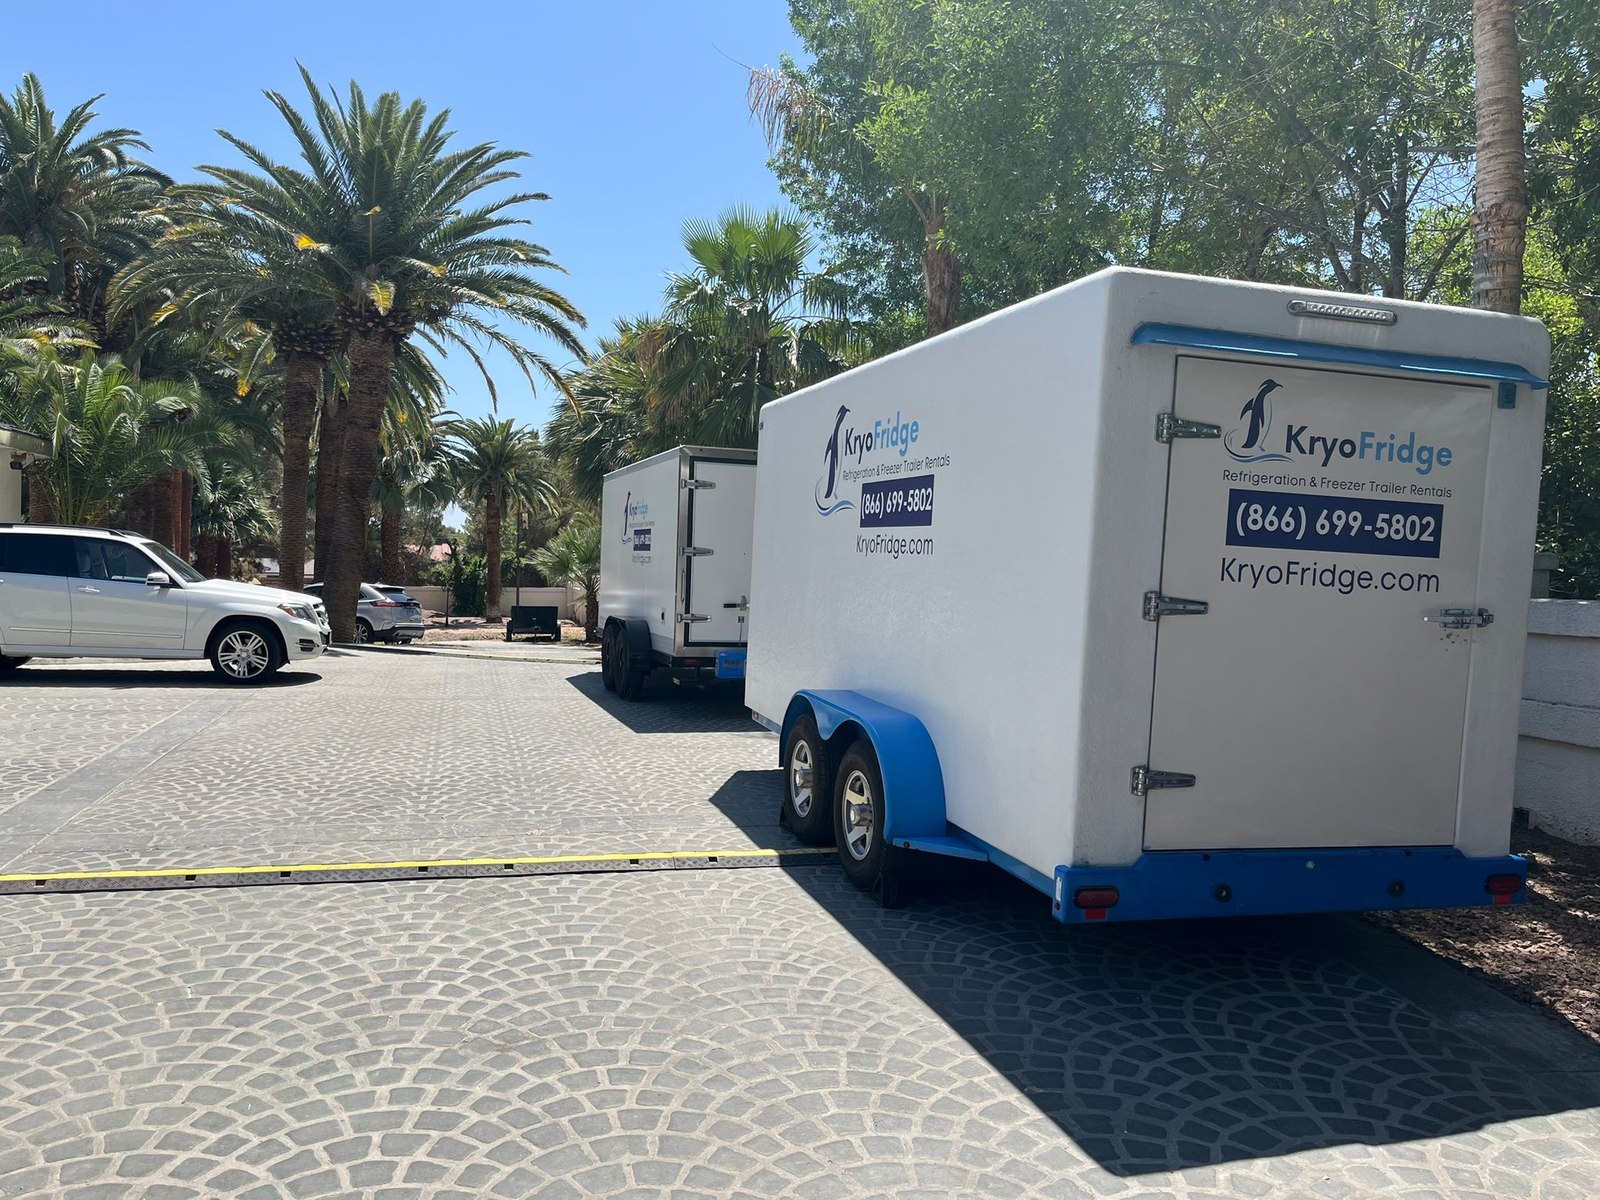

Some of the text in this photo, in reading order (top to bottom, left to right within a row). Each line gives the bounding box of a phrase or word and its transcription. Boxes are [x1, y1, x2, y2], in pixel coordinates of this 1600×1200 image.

[845, 411, 919, 464] KryoFridge
[1285, 424, 1453, 475] KryoFridge
[843, 454, 950, 482] Refrigeration & Freezer Trailer Rentals
[1223, 470, 1452, 498] Refrigeration & Freezer Trailer Rentals
[862, 488, 932, 519] (866) 699-5802
[1236, 502, 1436, 542] (866) 699-5802
[856, 534, 933, 559] KryoFridge.com
[1220, 557, 1440, 595] KryoFridge.com
